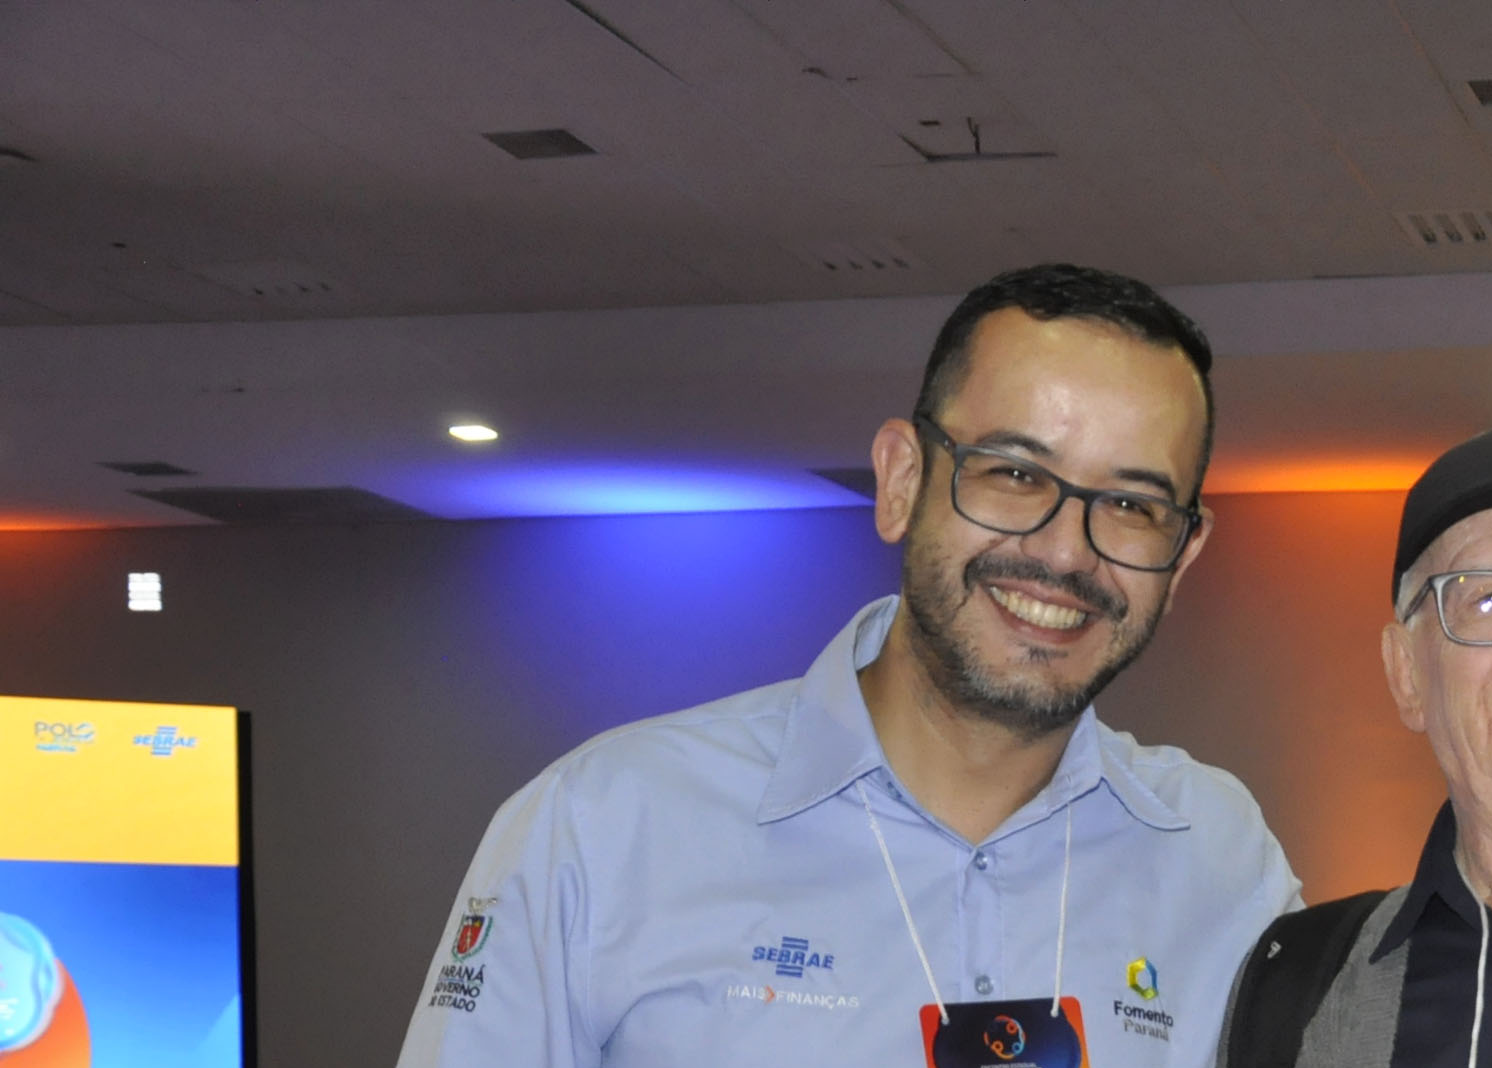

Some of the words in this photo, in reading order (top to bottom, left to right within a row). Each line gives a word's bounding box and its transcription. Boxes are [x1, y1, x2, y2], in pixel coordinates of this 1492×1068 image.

[752, 946, 835, 969] SEBRAE
[727, 984, 765, 1000] MAIS
[776, 991, 860, 1009] FINANÇAS
[1113, 1000, 1174, 1027] Fomento
[1124, 1019, 1169, 1042] Paraná
